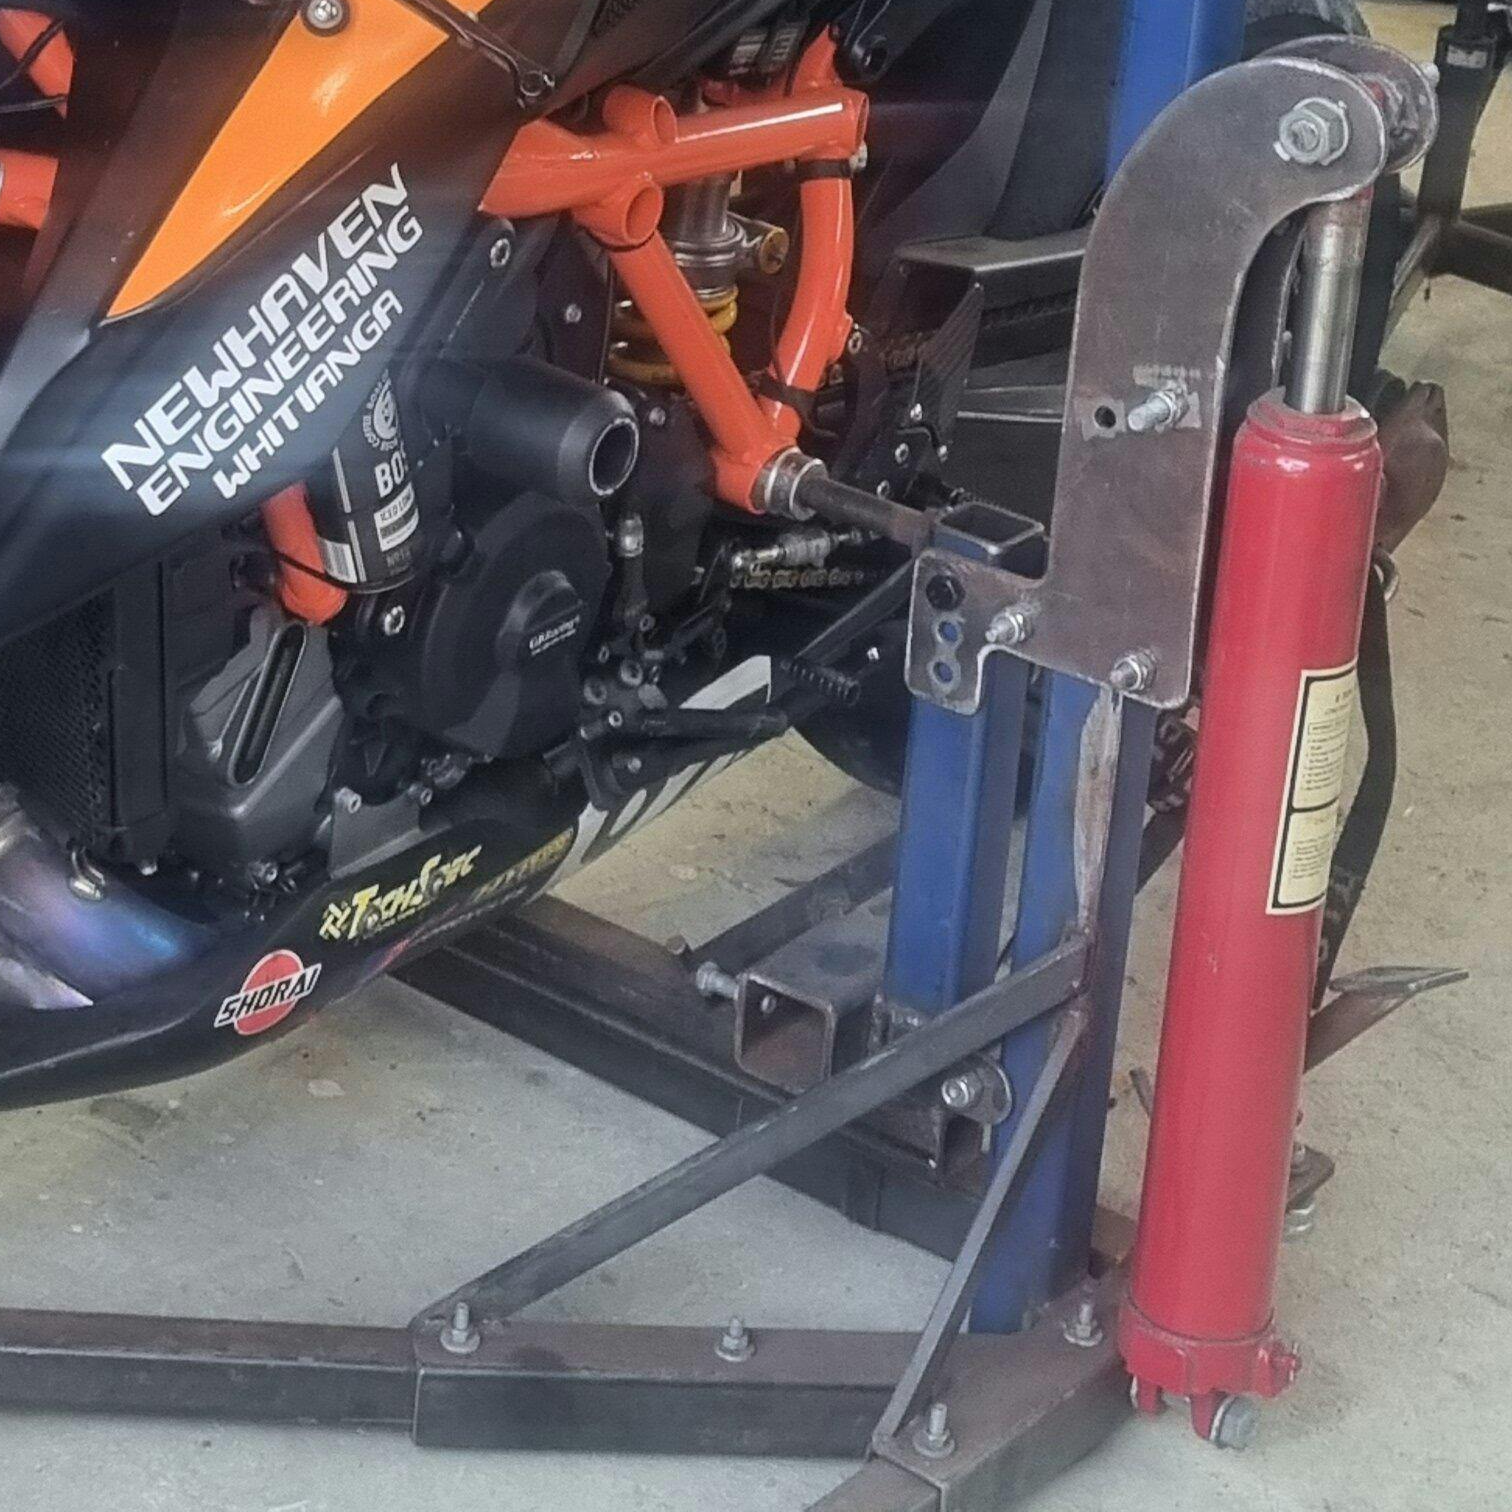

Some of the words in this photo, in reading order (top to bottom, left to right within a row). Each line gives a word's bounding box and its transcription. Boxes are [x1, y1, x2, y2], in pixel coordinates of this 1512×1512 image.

[101, 162, 409, 491] NEWHAVEN
[135, 205, 424, 517] ENGINEERING
[212, 290, 404, 501] WHITIANGA
[217, 967, 319, 1024] SHORAI
